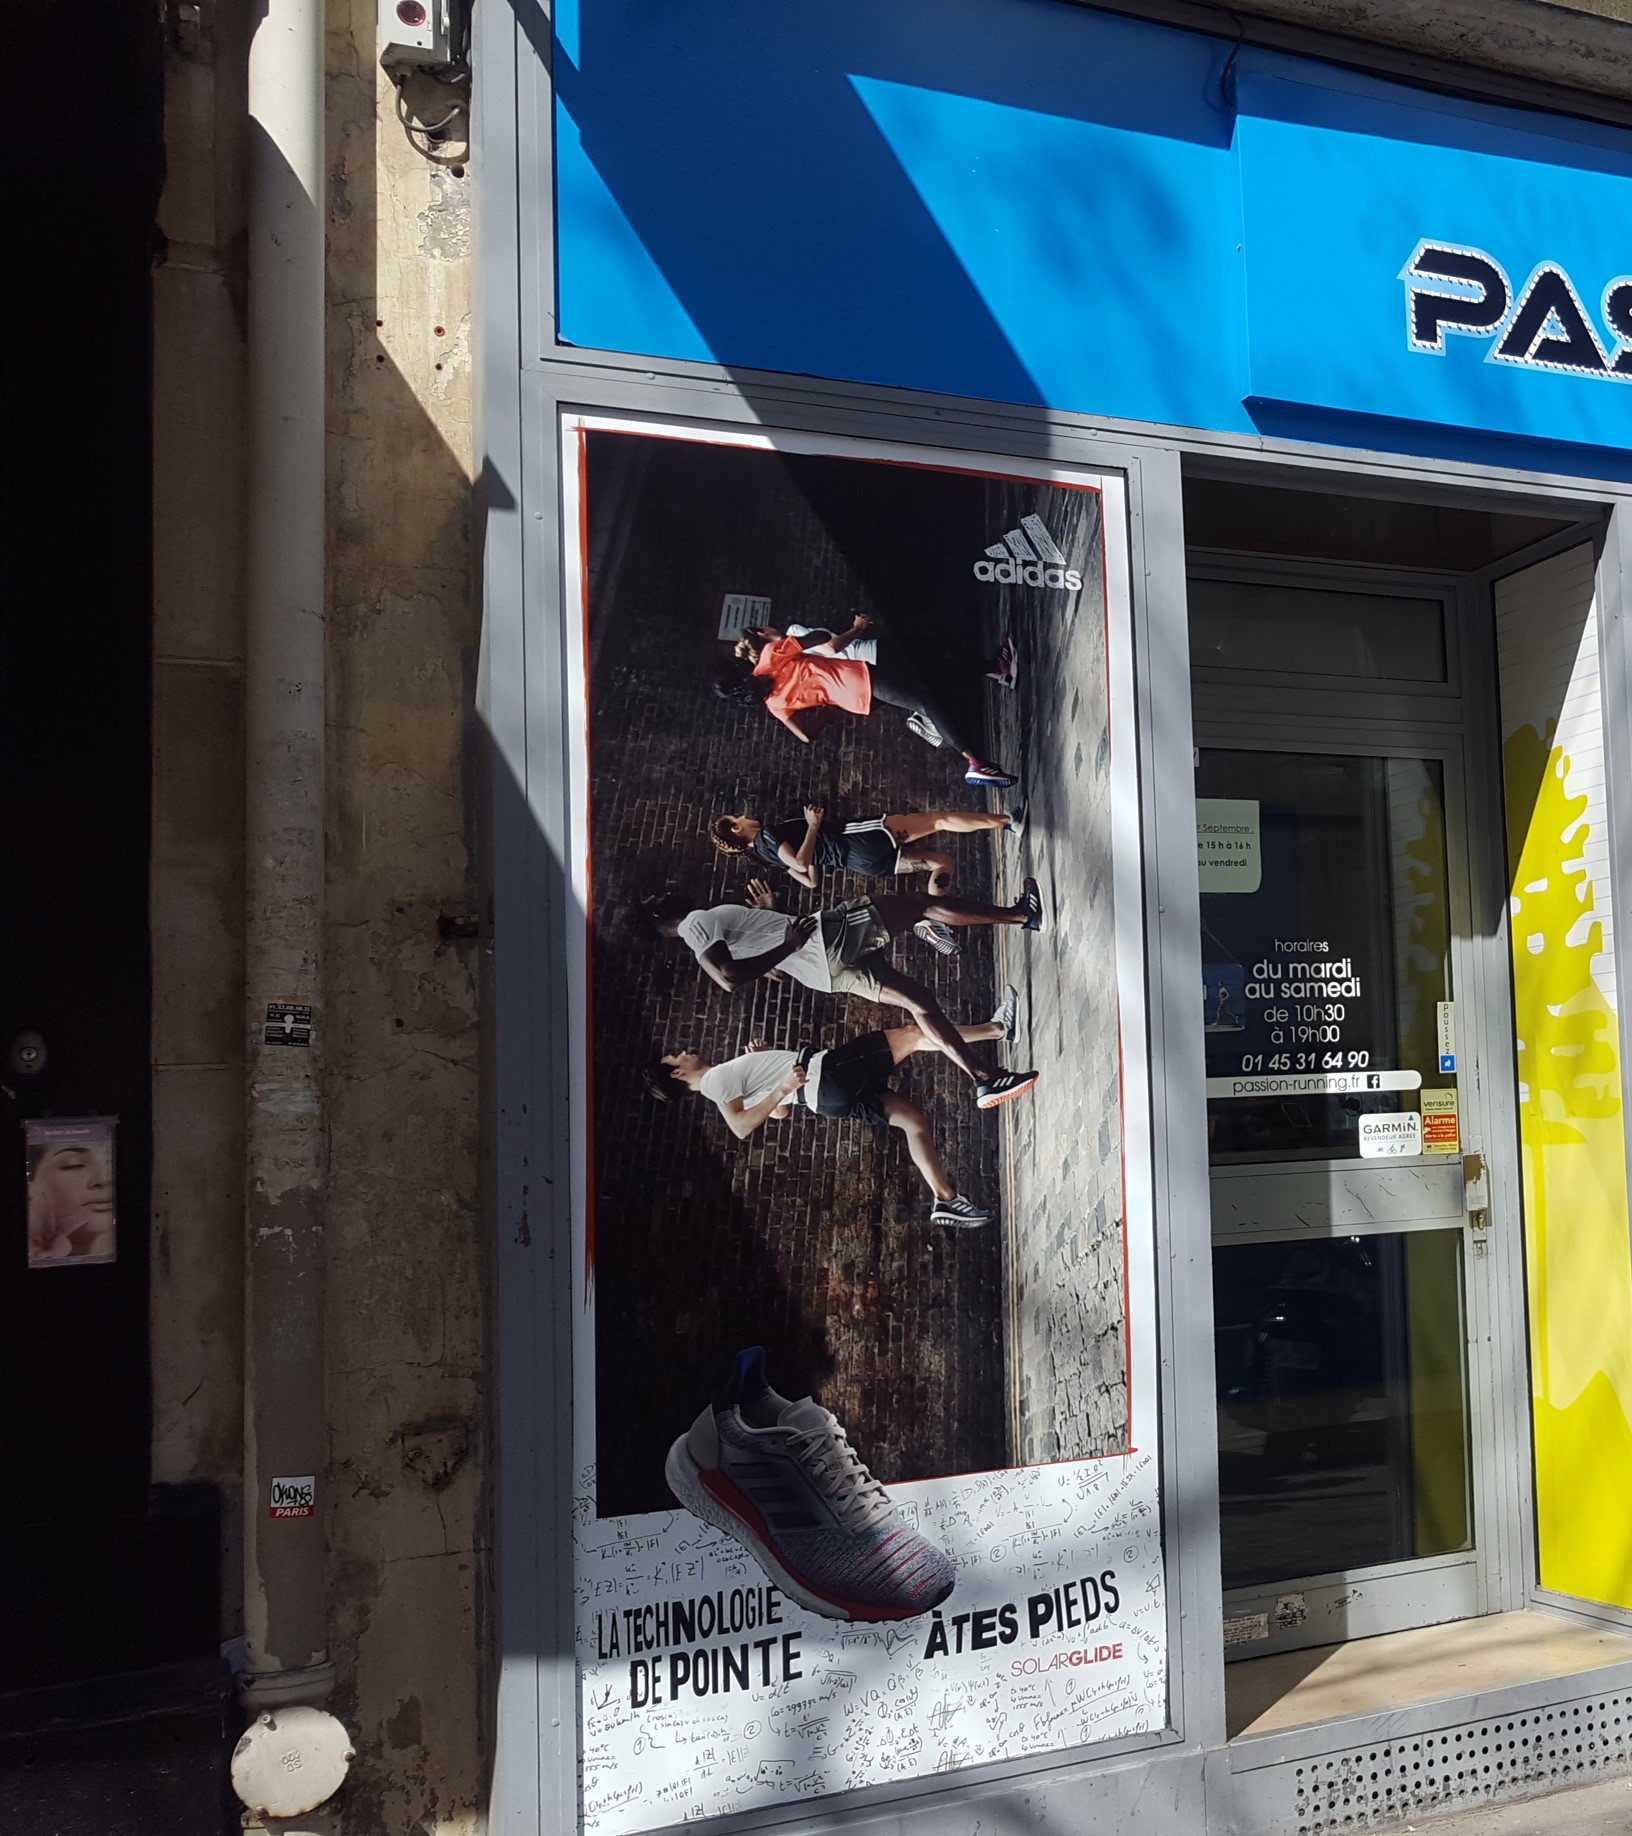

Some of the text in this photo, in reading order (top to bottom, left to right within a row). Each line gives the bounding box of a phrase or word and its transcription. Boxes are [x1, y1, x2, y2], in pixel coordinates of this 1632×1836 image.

[973, 556, 1083, 592] adidas
[1202, 823, 1250, 833] Septembre
[1206, 841, 1217, 849] 15
[1235, 841, 1244, 850] 16
[1209, 859, 1248, 867] vendredi
[1274, 939, 1329, 952] horaires
[1252, 958, 1352, 979] du mardi
[1245, 977, 1361, 999] au samedi
[1264, 1004, 1345, 1022] de 10h30
[1271, 1025, 1340, 1043] à 19h00
[1442, 1003, 1450, 1055] poussez
[1242, 1051, 1369, 1072] 01 45 31 64 90
[1232, 1074, 1360, 1096] passion-running.fr
[1423, 1100, 1455, 1108] verisure
[1424, 1115, 1456, 1126] Alarme
[275, 1506, 309, 1517] PARIS
[1027, 1569, 1120, 1640] PIEDS
[623, 1586, 783, 1655] TECHNOLOGIE
[630, 1631, 803, 1709] DE POINTE
[1010, 1642, 1123, 1678] SOLARGLIDE
